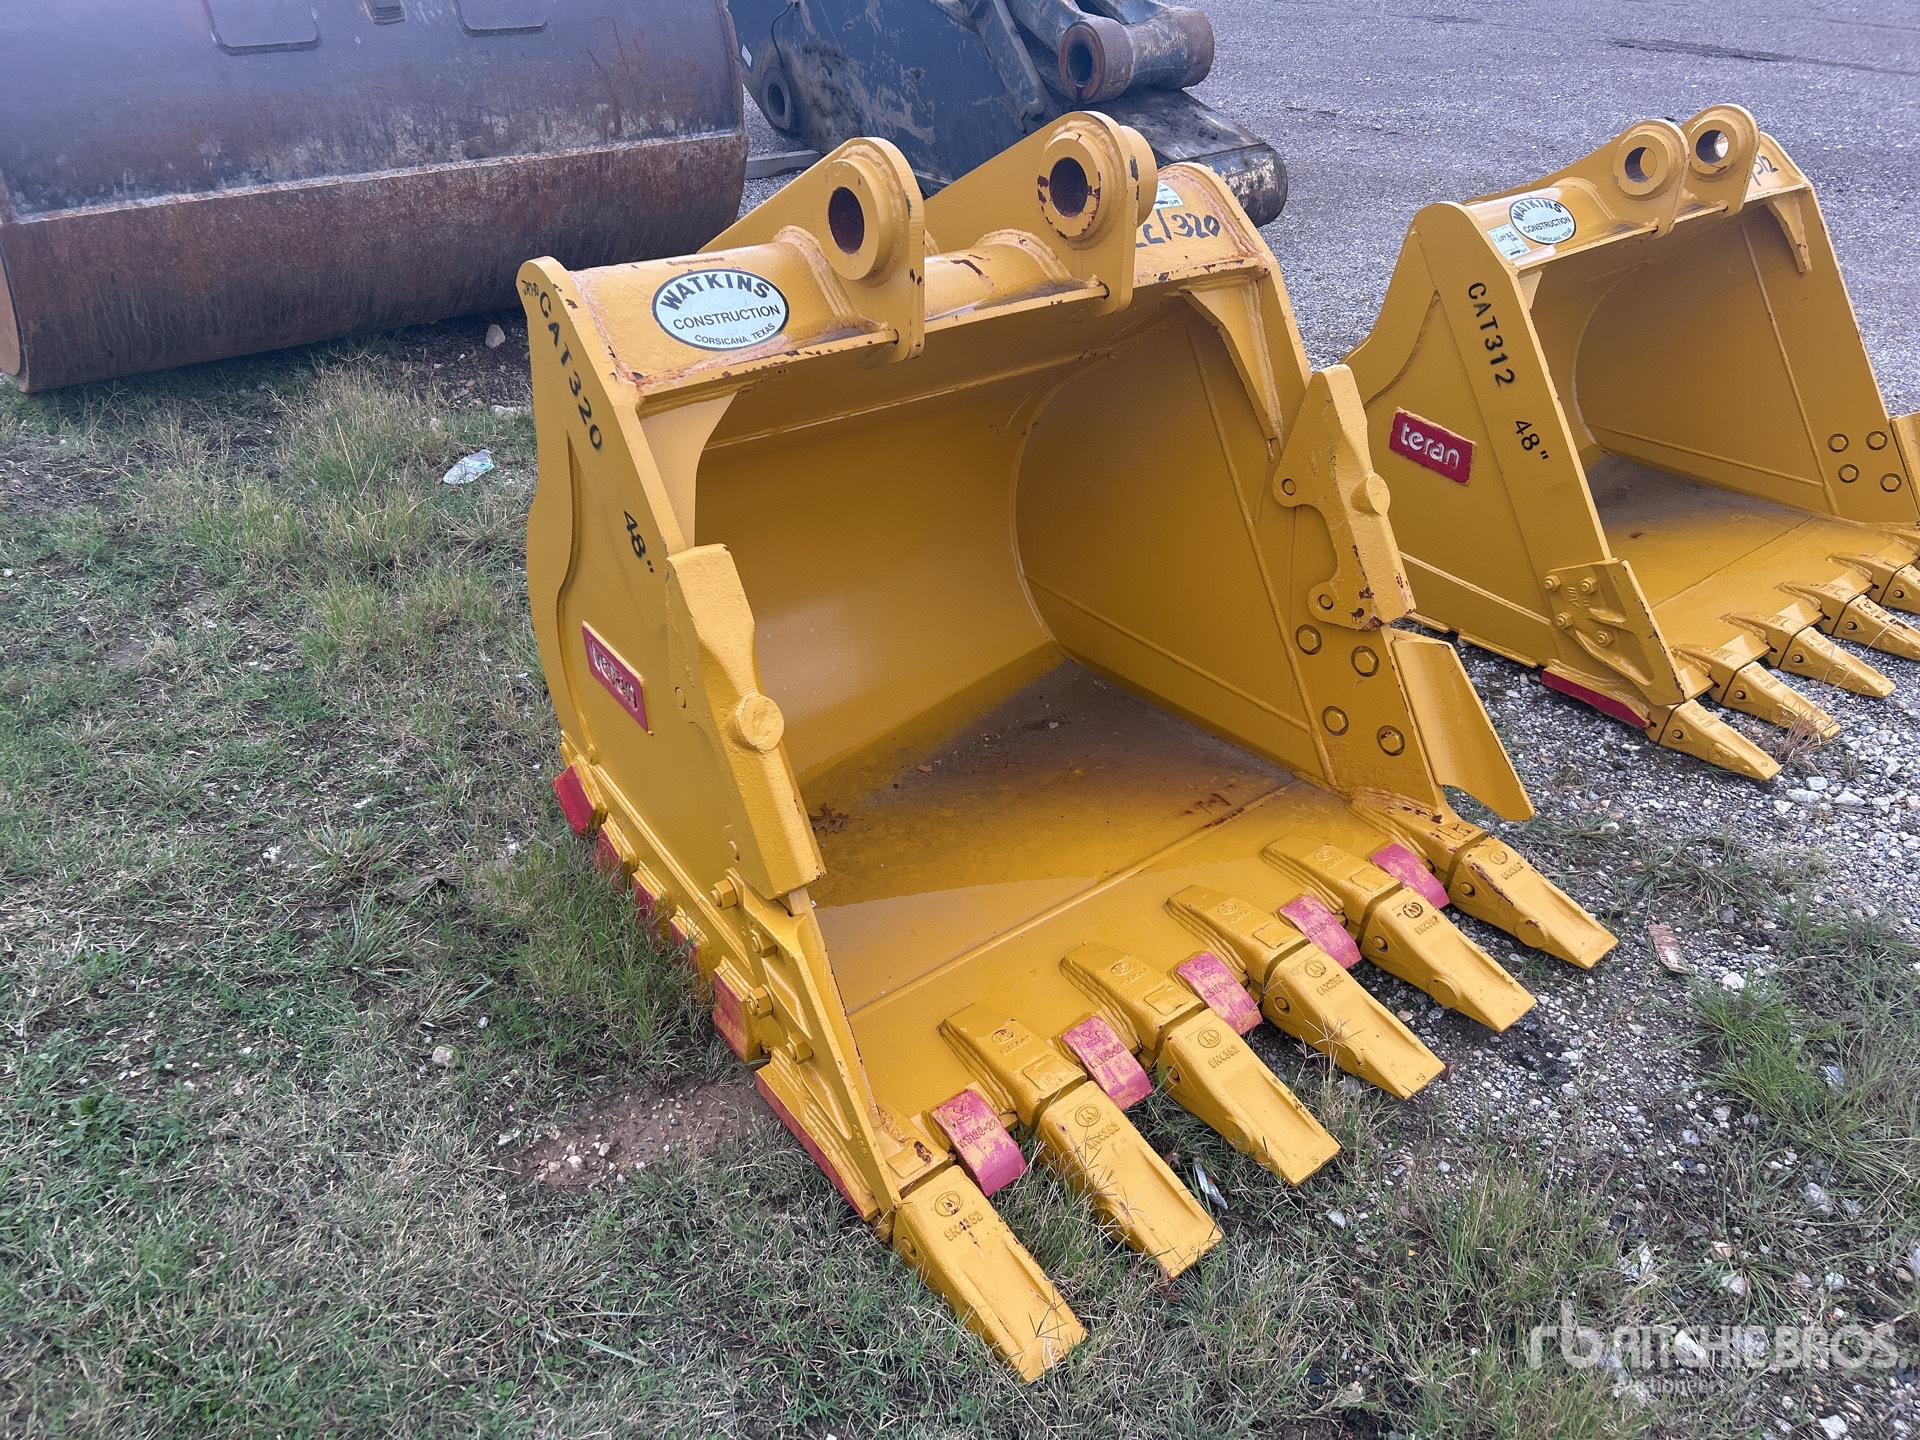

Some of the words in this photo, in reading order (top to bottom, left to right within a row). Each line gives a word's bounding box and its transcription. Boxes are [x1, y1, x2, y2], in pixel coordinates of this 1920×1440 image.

[1513, 199, 1562, 222] WATKINS
[1522, 215, 1572, 234] CONSTRUCTION
[660, 273, 770, 312] WATKINS
[673, 304, 781, 331] CONSTRUCTION
[694, 333, 751, 346] CORSICANA,
[751, 322, 776, 341] TEXAS
[1467, 282, 1516, 388] CAT312
[539, 291, 603, 450] CAT320
[1400, 421, 1461, 469] teran
[1515, 419, 1550, 461] 48"
[624, 510, 655, 574] 48"
[589, 639, 639, 711] teran
